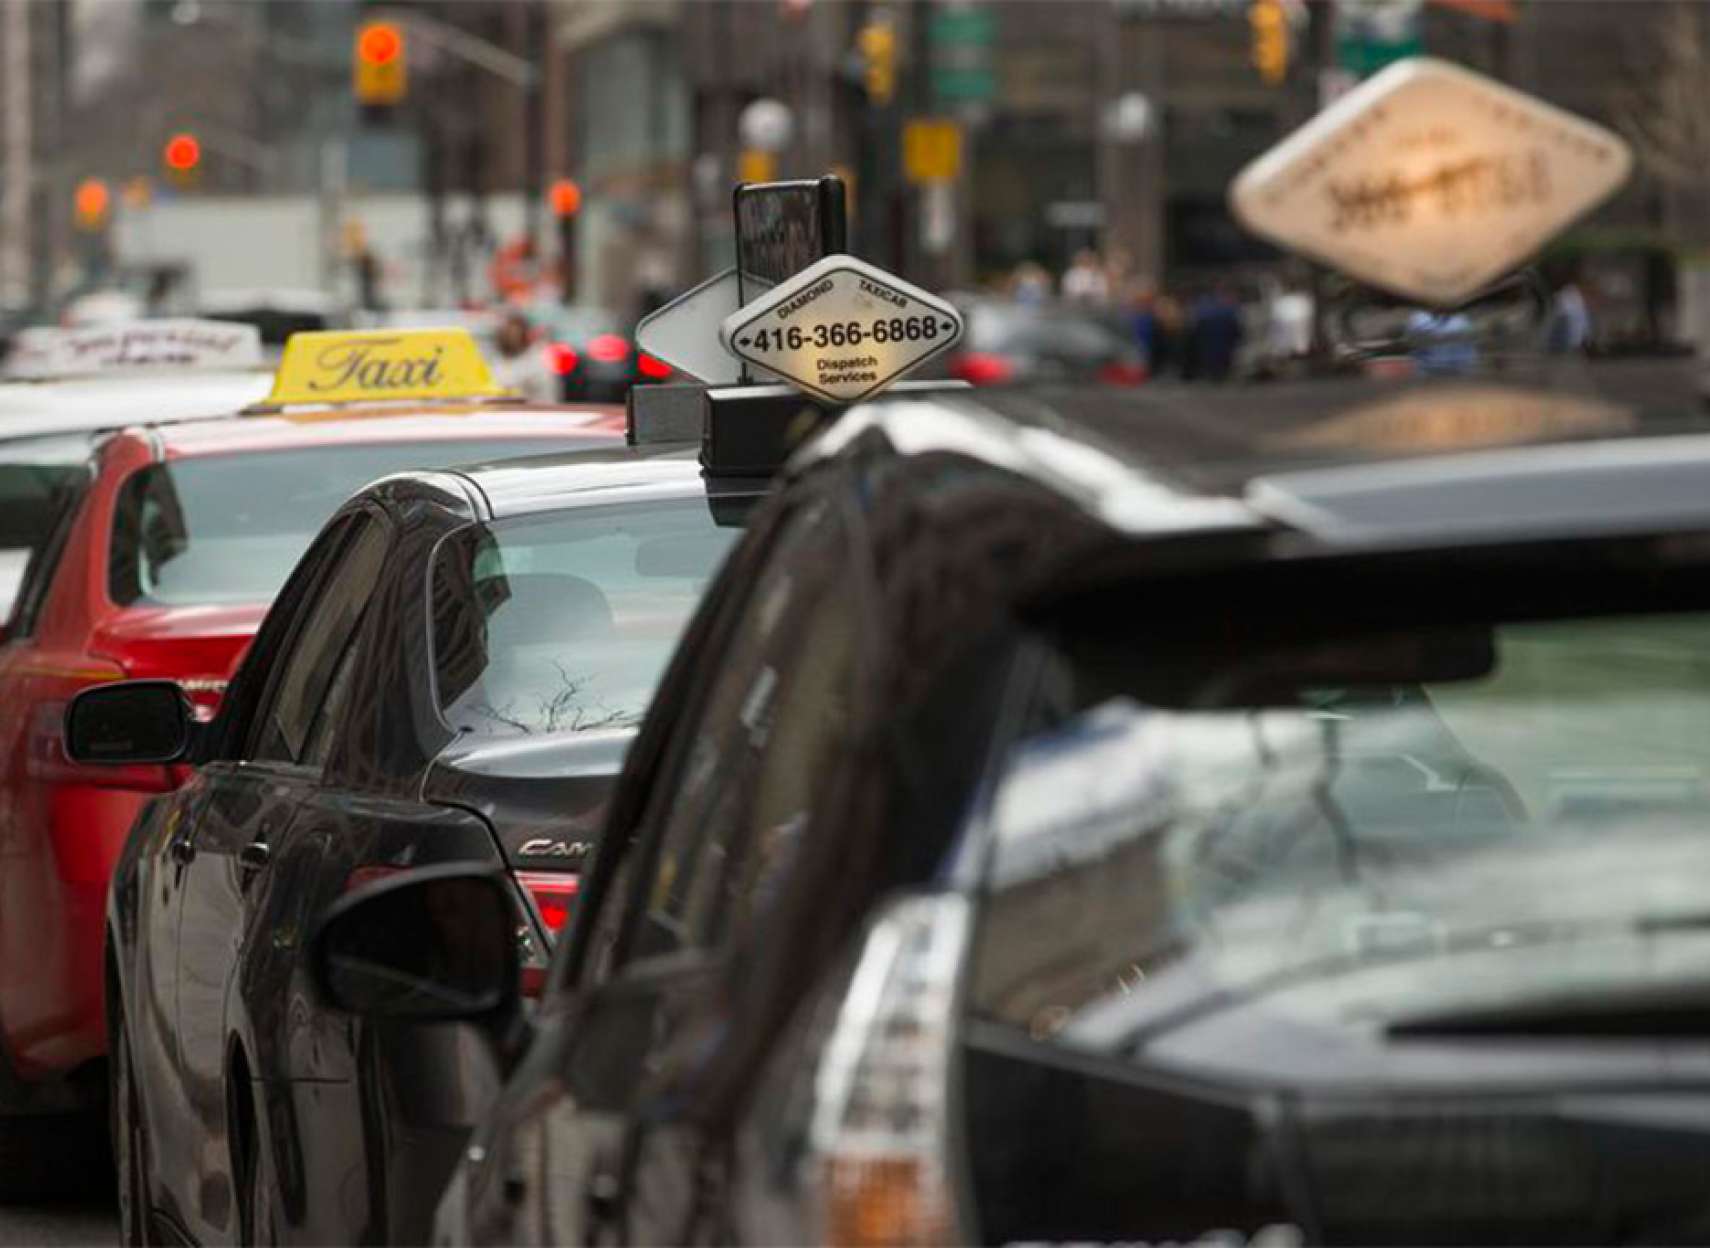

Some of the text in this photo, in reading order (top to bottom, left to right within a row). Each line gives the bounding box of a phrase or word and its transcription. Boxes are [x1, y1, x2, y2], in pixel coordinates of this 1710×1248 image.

[777, 278, 909, 320] DIAMOND TAXICAB
[753, 315, 938, 352] 416-366-6868
[307, 336, 445, 392] Taxi
[816, 354, 878, 373] Dispatch
[818, 370, 878, 386] Services
